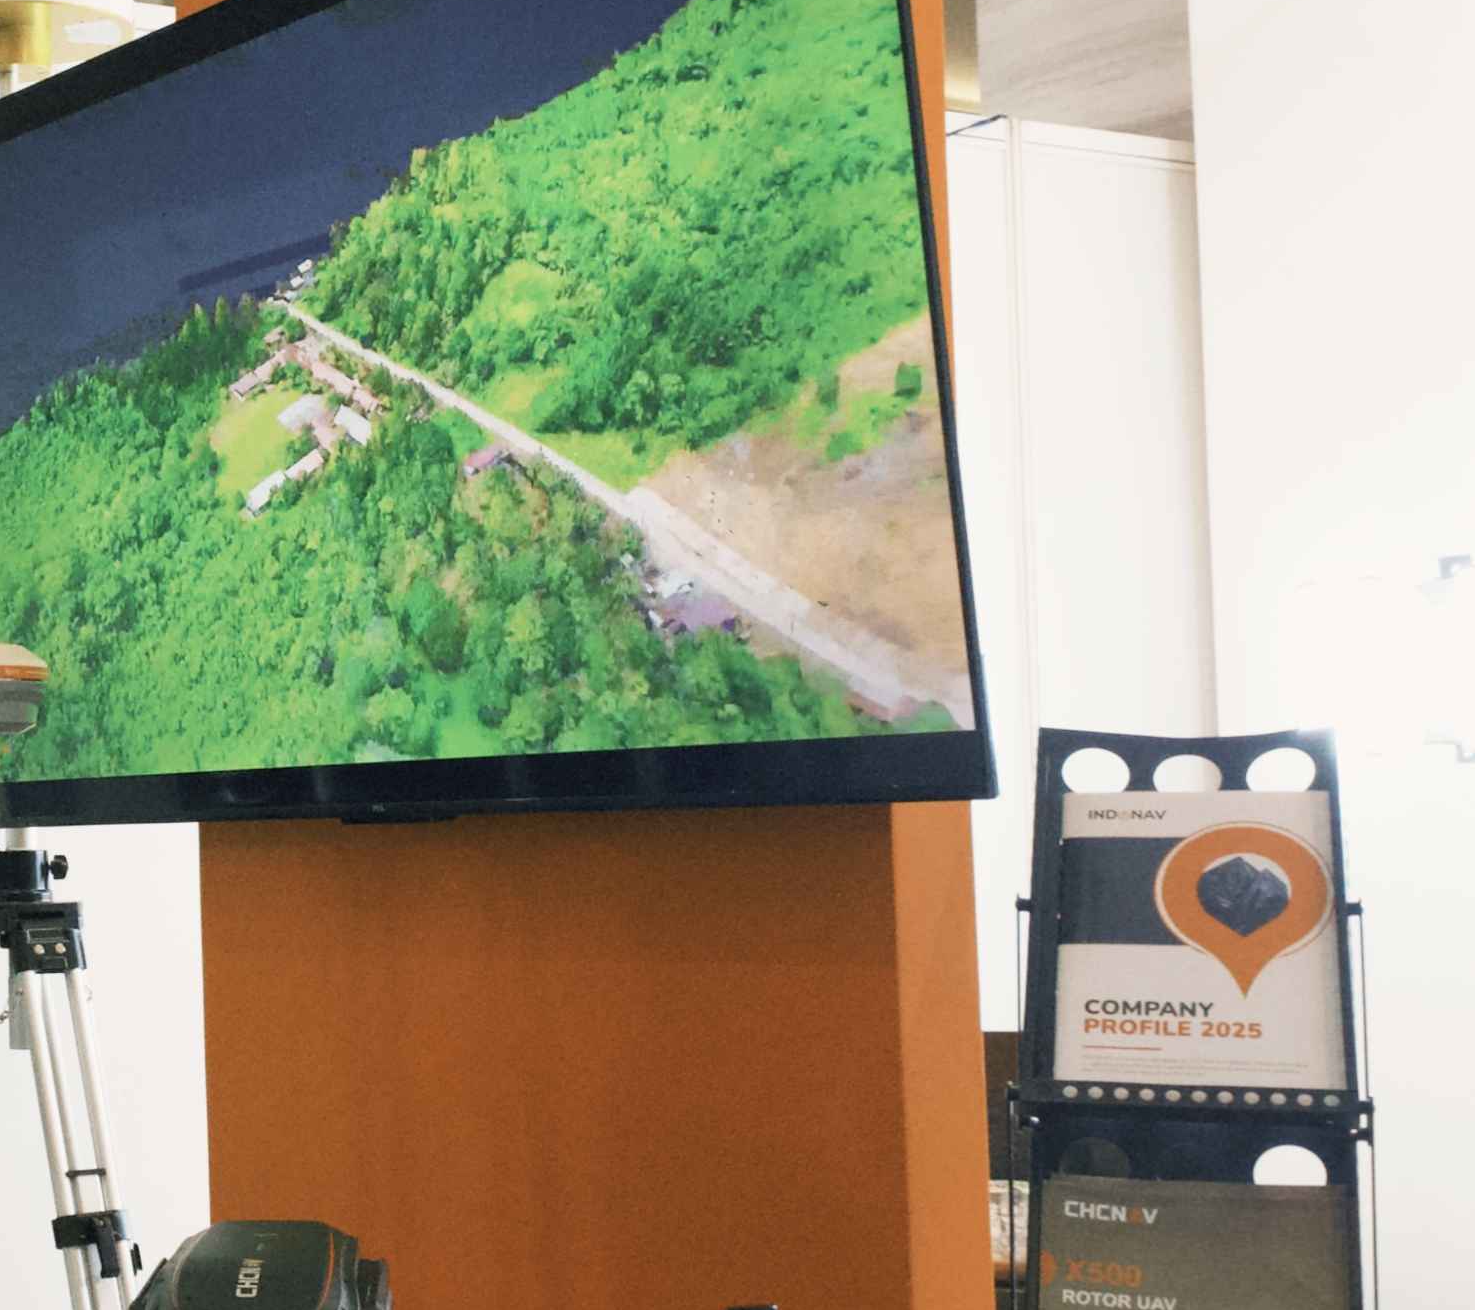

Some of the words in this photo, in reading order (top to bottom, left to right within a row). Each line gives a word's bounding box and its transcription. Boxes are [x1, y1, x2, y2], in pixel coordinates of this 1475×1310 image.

[1084, 998, 1214, 1018] COMPANY
[1084, 1018, 1192, 1037] PROFILE
[1201, 1021, 1263, 1039] 2025
[1064, 1200, 1158, 1224] CHCNAV
[1062, 1290, 1132, 1309] ROTOR
